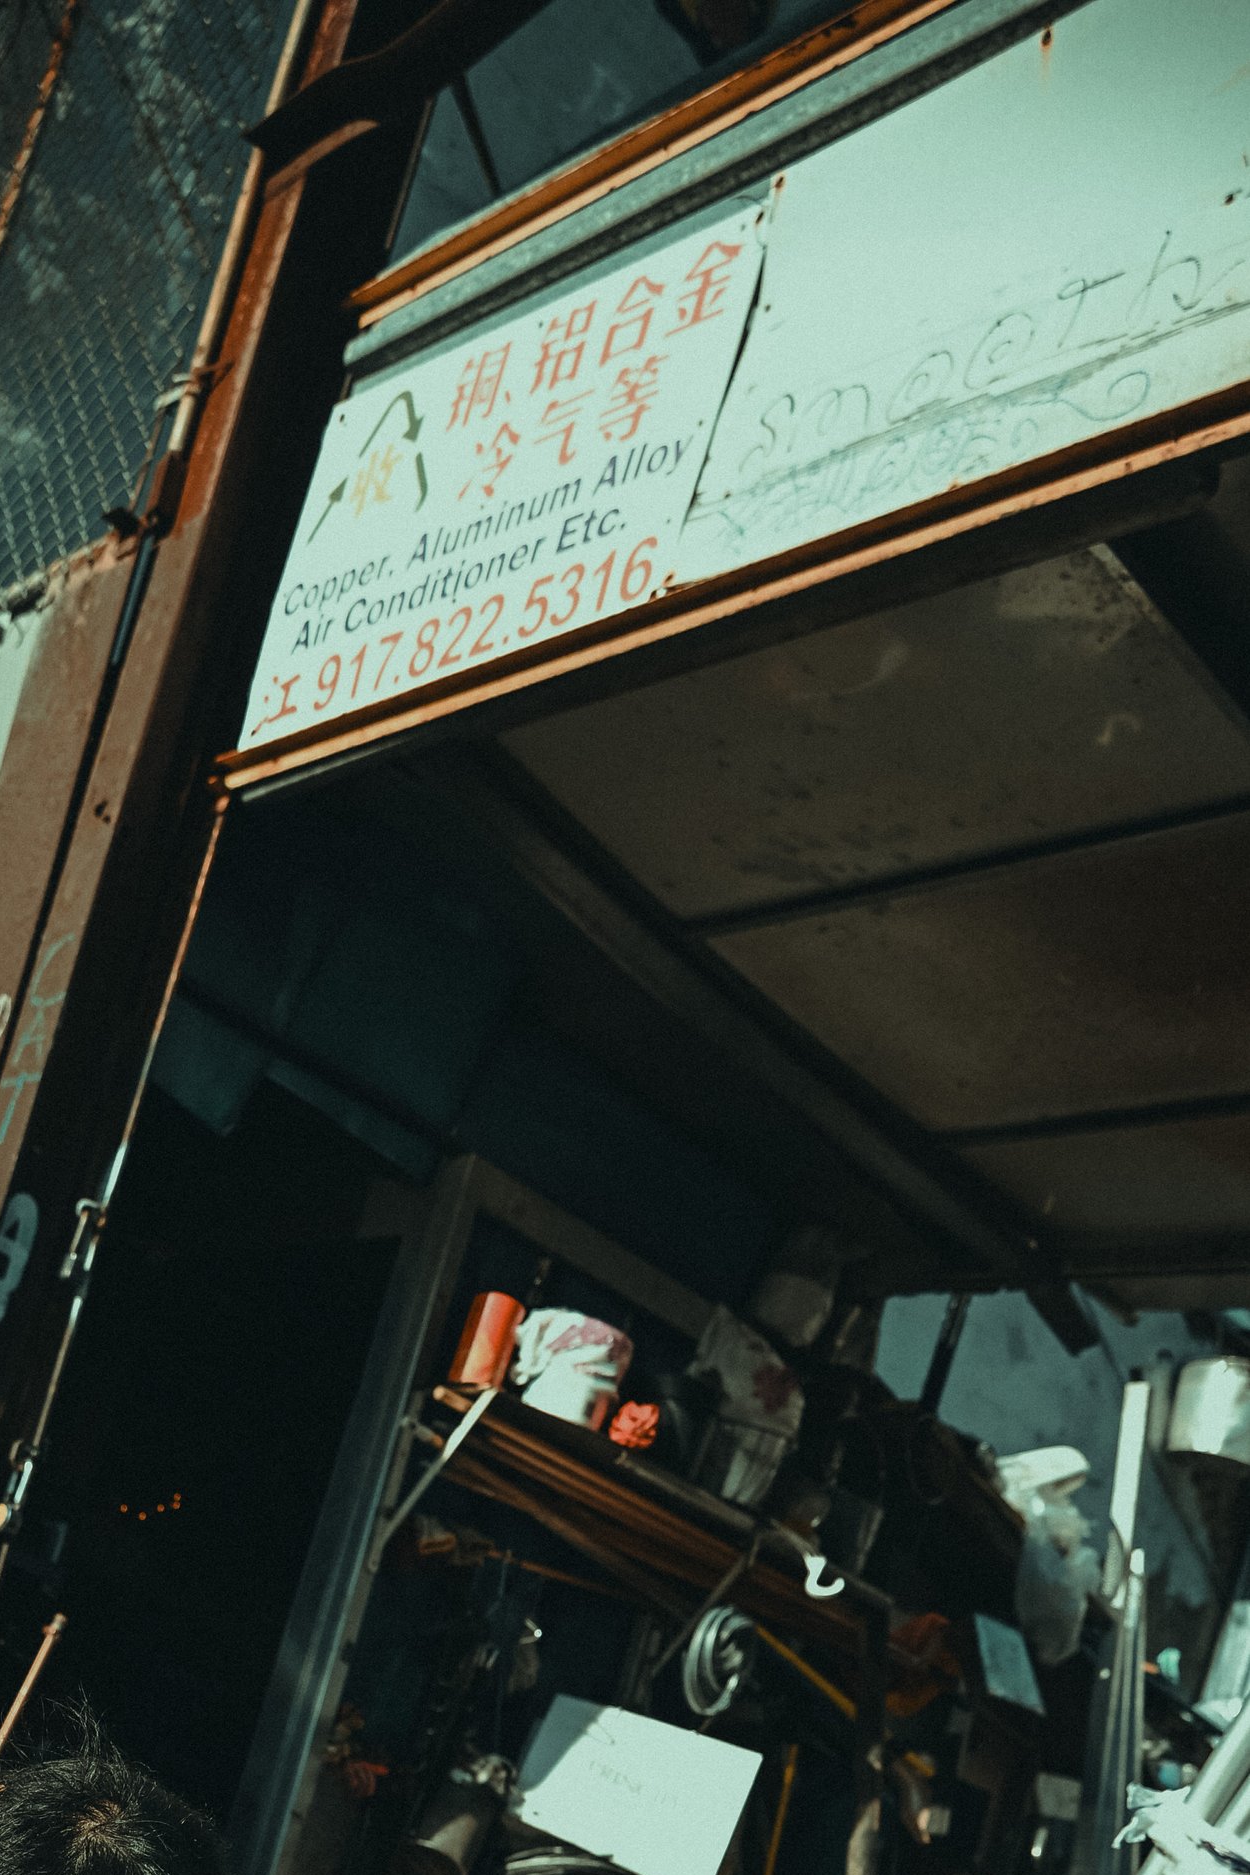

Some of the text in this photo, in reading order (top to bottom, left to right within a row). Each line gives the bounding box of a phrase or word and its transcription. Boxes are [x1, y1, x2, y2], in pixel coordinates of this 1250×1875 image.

[407, 477, 582, 569] Aluminum
[592, 434, 694, 498] Alloy
[458, 353, 668, 502] 冷气等
[290, 505, 627, 655] Air Conditioner Etc.
[313, 536, 659, 712] 917.822.5316
